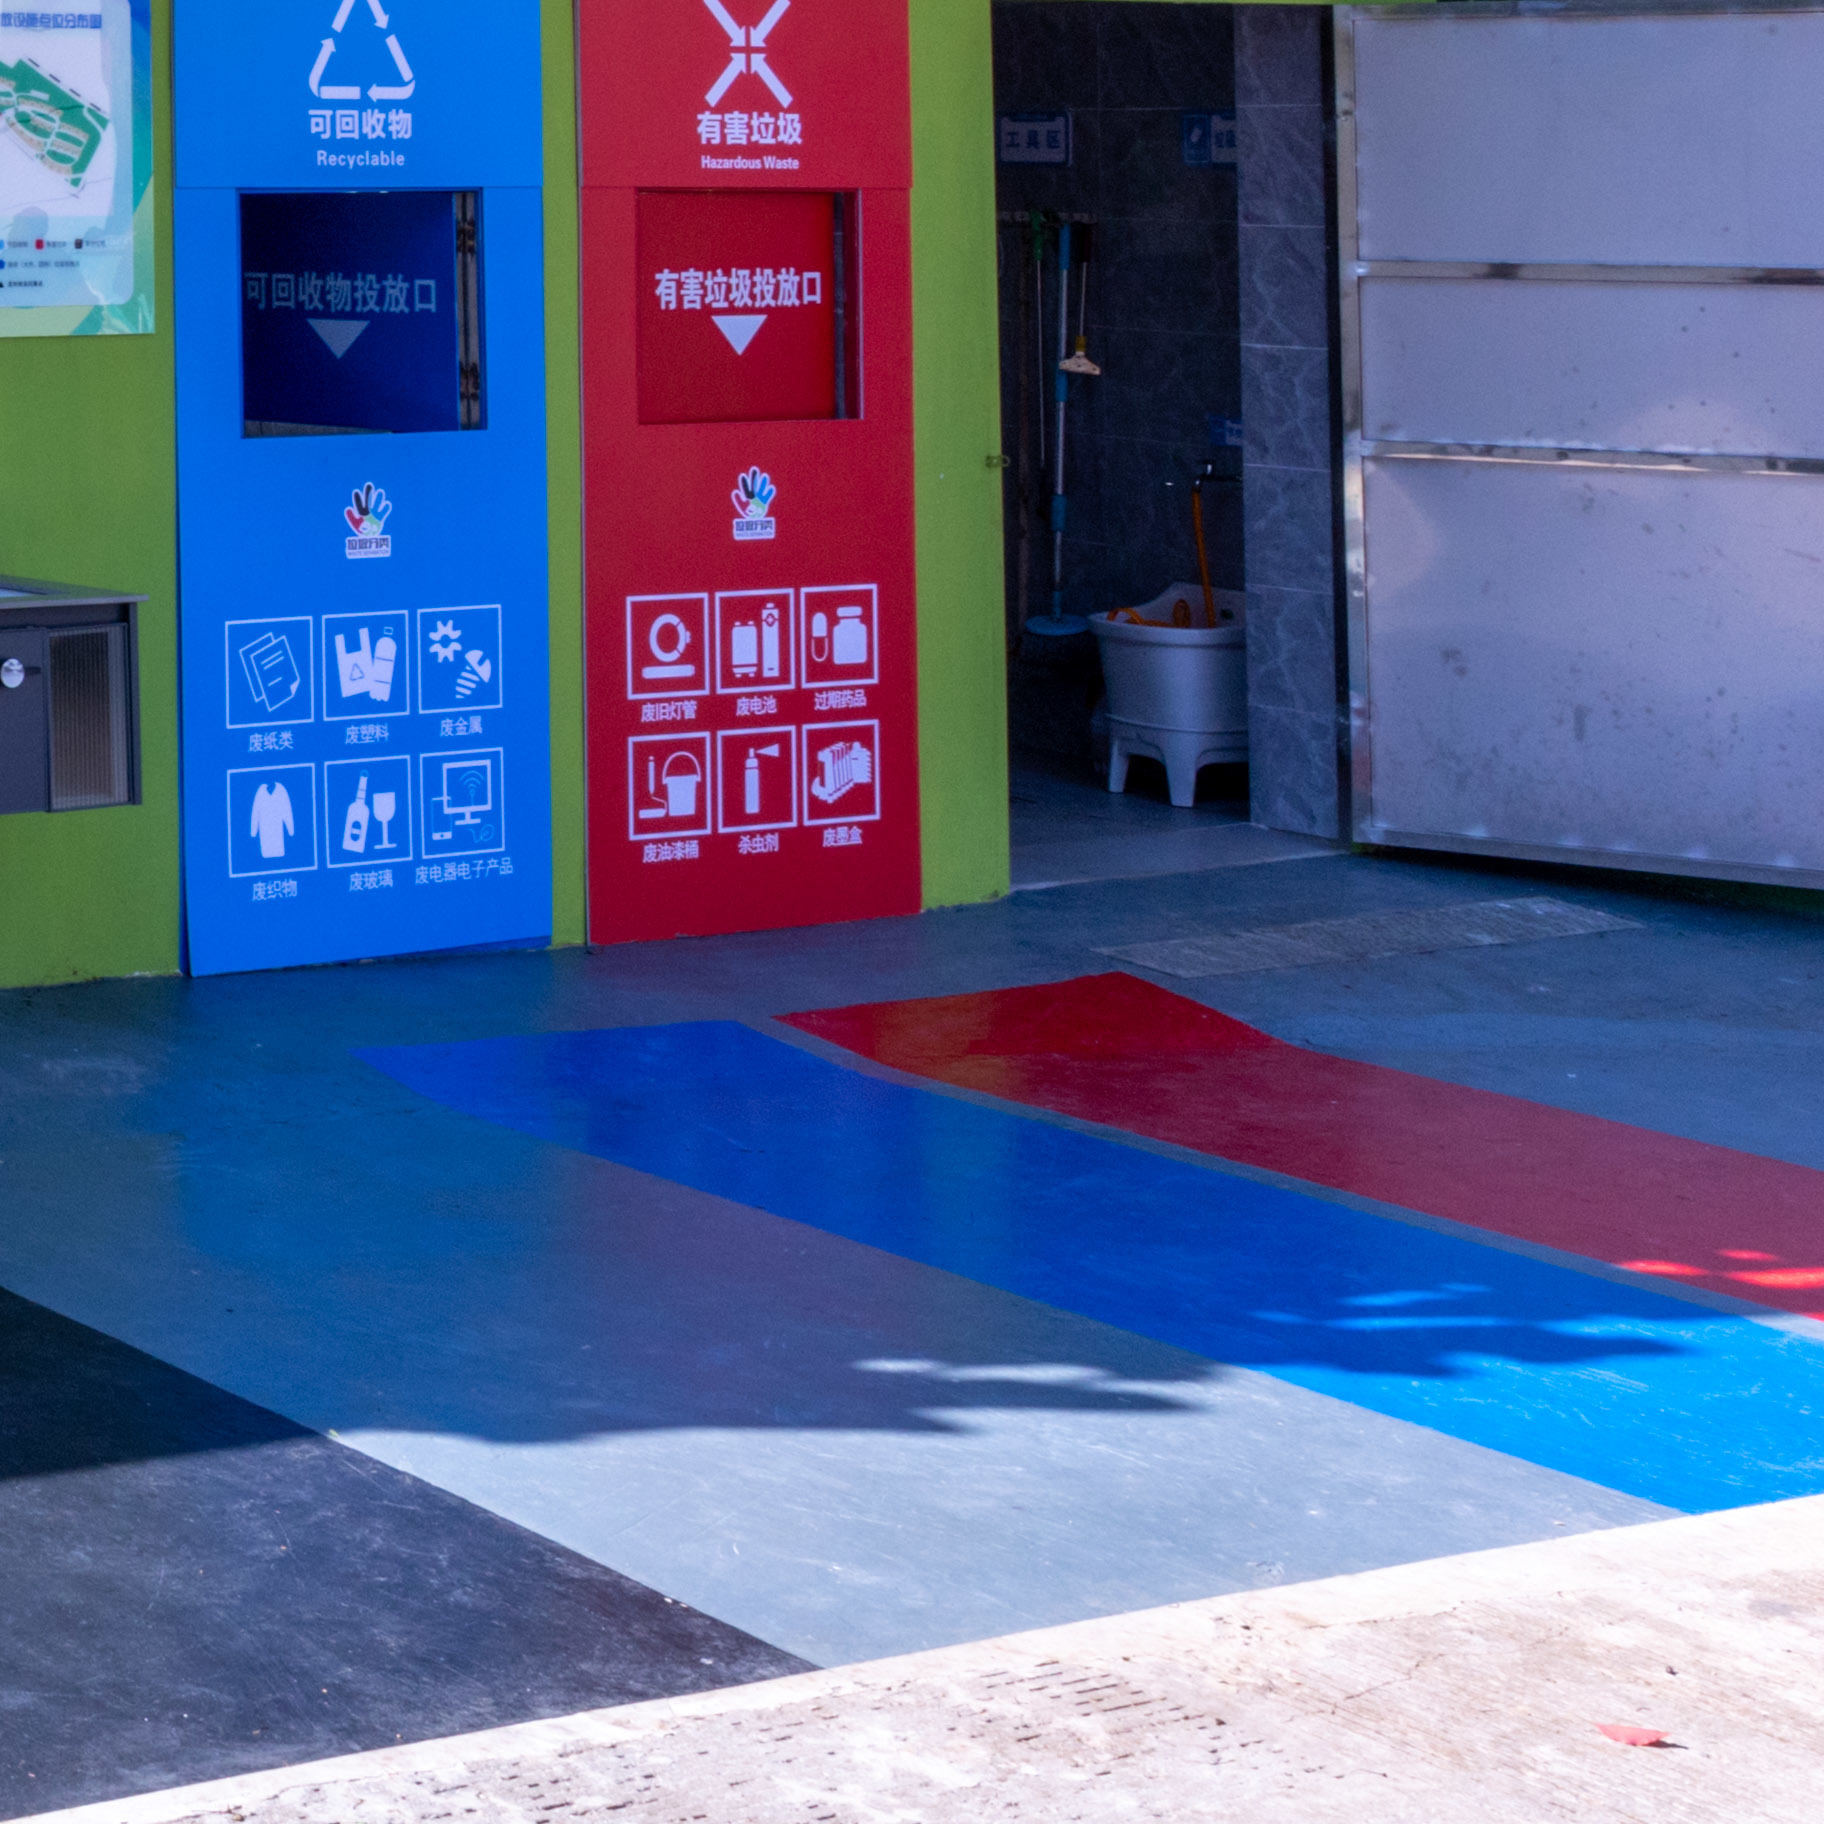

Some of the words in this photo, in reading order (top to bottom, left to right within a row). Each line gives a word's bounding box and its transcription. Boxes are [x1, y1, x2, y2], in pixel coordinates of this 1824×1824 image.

[308, 108, 412, 142] 可回收物
[697, 111, 803, 146] 有害垃圾
[1006, 130, 1061, 150] 工具区
[316, 150, 406, 169] Recyclable
[701, 155, 761, 170] Hazardous
[763, 156, 800, 171] Waste
[244, 271, 438, 313] 可回收物投放口
[654, 267, 822, 311] 有害垃圾投放口
[641, 698, 698, 723] 废旧灯管
[735, 694, 778, 716] 废电池
[813, 688, 867, 711] 过期药品
[345, 723, 390, 745] 废塑料
[439, 716, 483, 737] 废金属
[248, 730, 294, 752] 废纸类
[737, 832, 779, 855] 杀虫剂
[821, 825, 863, 847] 废墨盒
[642, 839, 700, 863] 废油漆桶
[349, 870, 394, 892] 废玻璃
[415, 856, 514, 885] 废电器电子产品
[251, 880, 298, 902] 废织物
